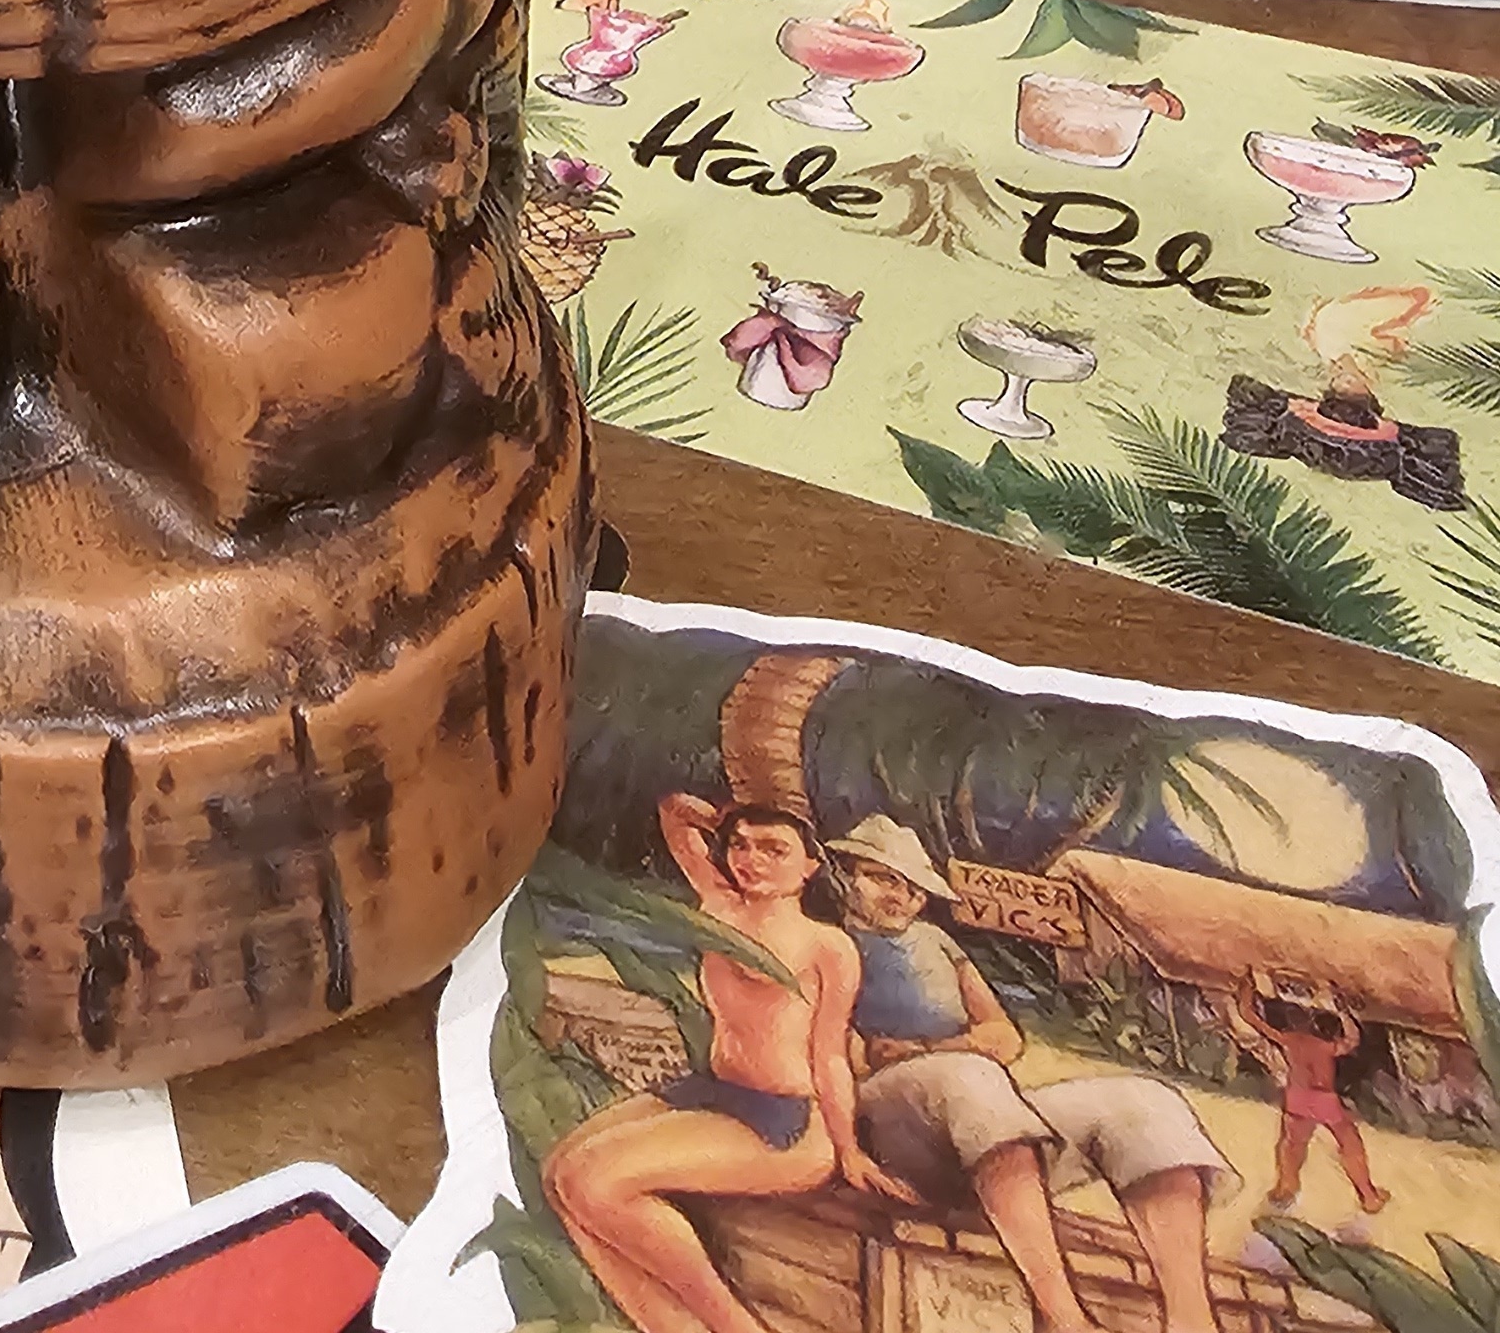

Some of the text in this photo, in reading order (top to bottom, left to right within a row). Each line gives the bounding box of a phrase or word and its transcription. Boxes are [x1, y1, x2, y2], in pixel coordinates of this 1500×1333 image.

[628, 96, 1272, 316] Hale Pele
[957, 865, 1074, 912] TRADER
